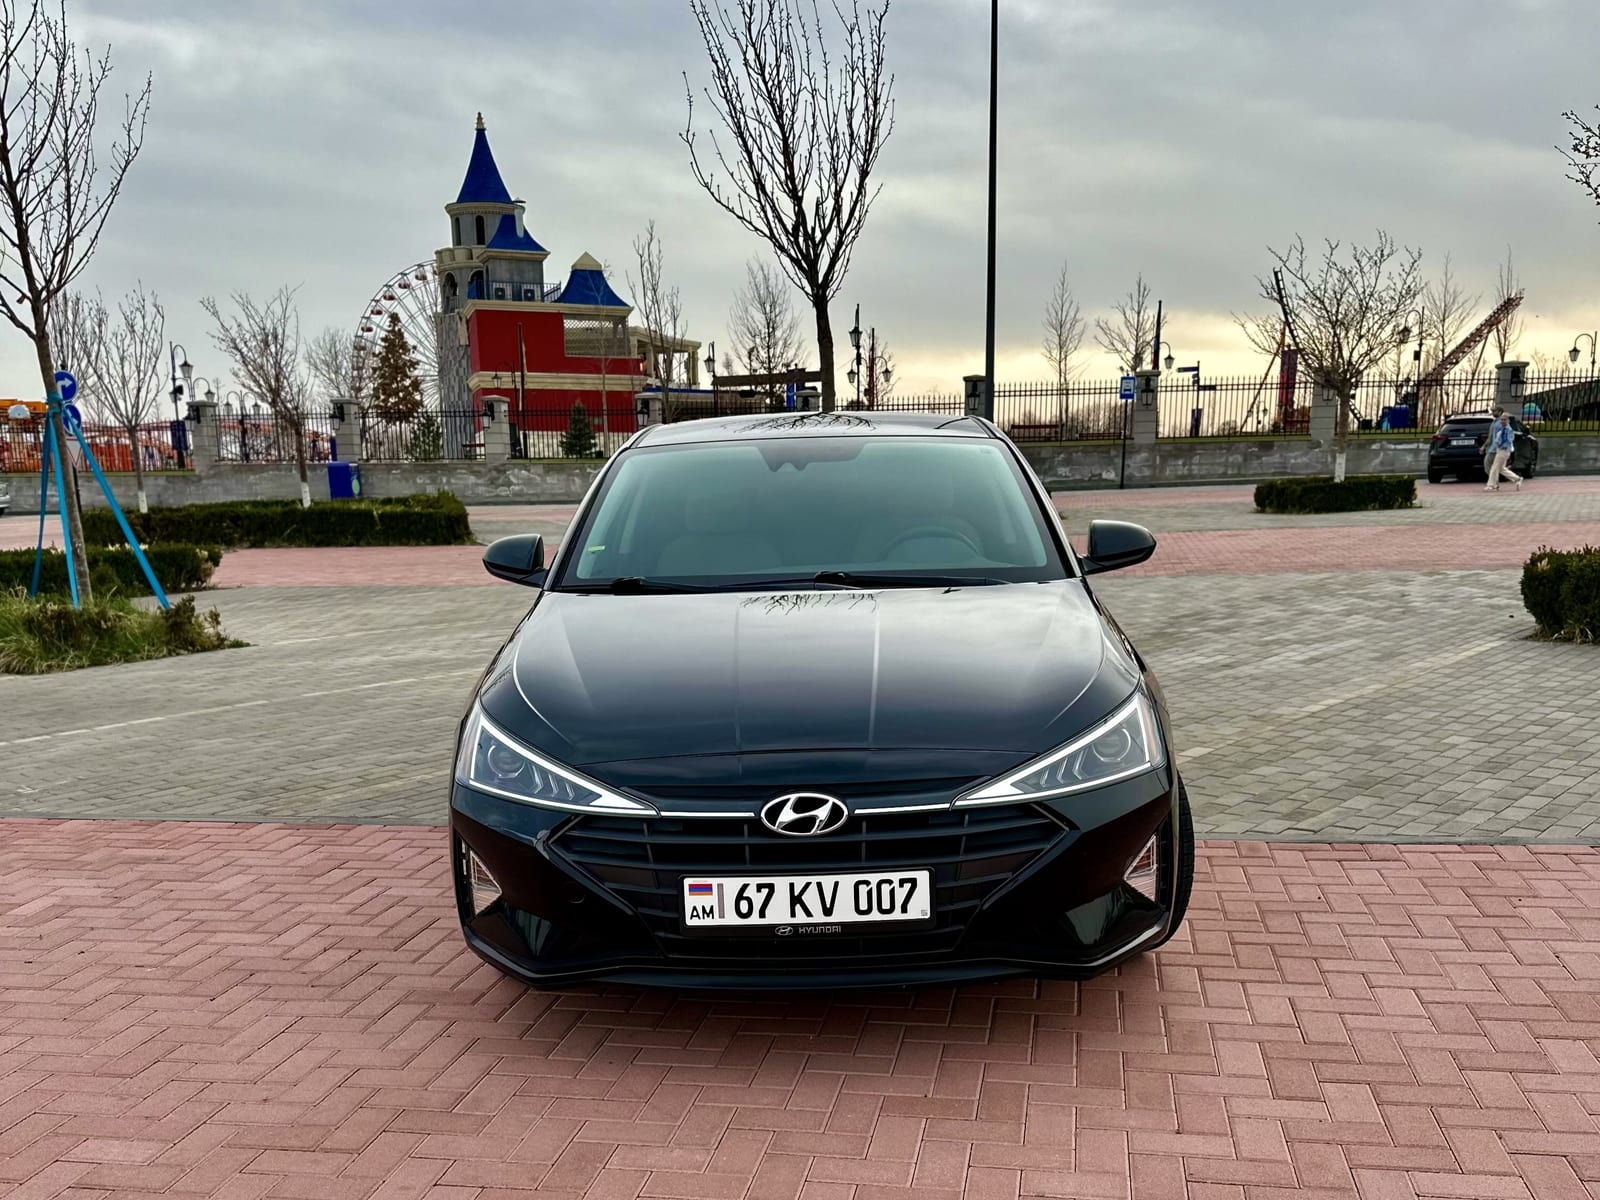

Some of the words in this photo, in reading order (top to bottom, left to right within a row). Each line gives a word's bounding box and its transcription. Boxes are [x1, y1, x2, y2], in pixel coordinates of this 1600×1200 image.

[734, 883, 775, 920] 67
[789, 880, 840, 918] KV
[853, 877, 918, 916] 007
[689, 904, 715, 921] AM
[798, 925, 842, 935] HYUNDAI
